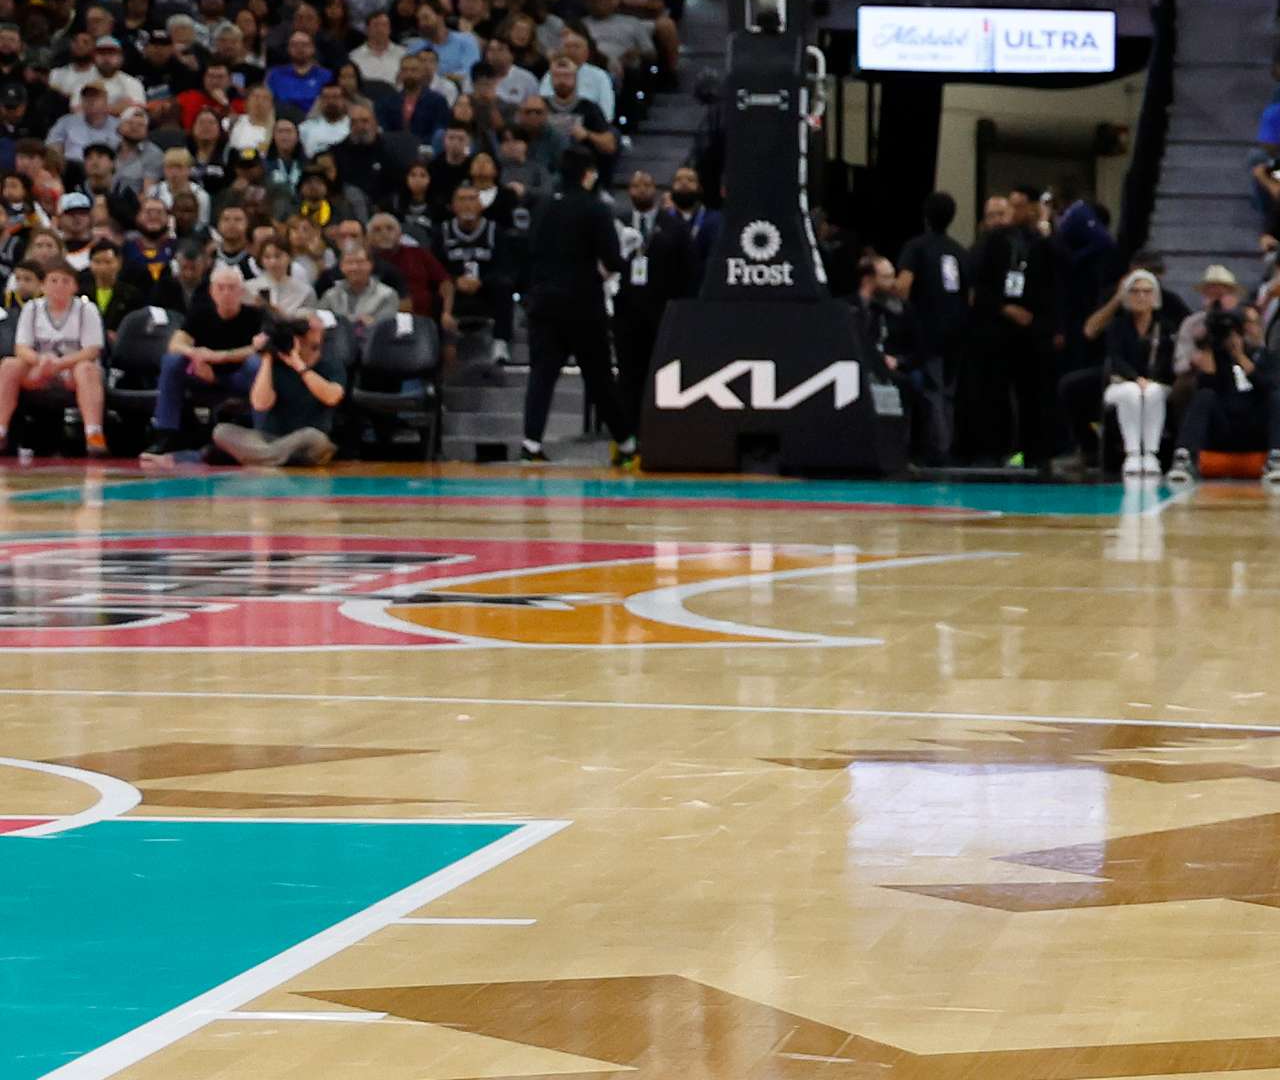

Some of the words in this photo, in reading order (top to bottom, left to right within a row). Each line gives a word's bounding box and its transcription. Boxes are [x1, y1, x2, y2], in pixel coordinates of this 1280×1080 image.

[1004, 29, 1100, 50] ULTRA
[726, 257, 795, 286] Frost
[654, 359, 861, 410] KIA
